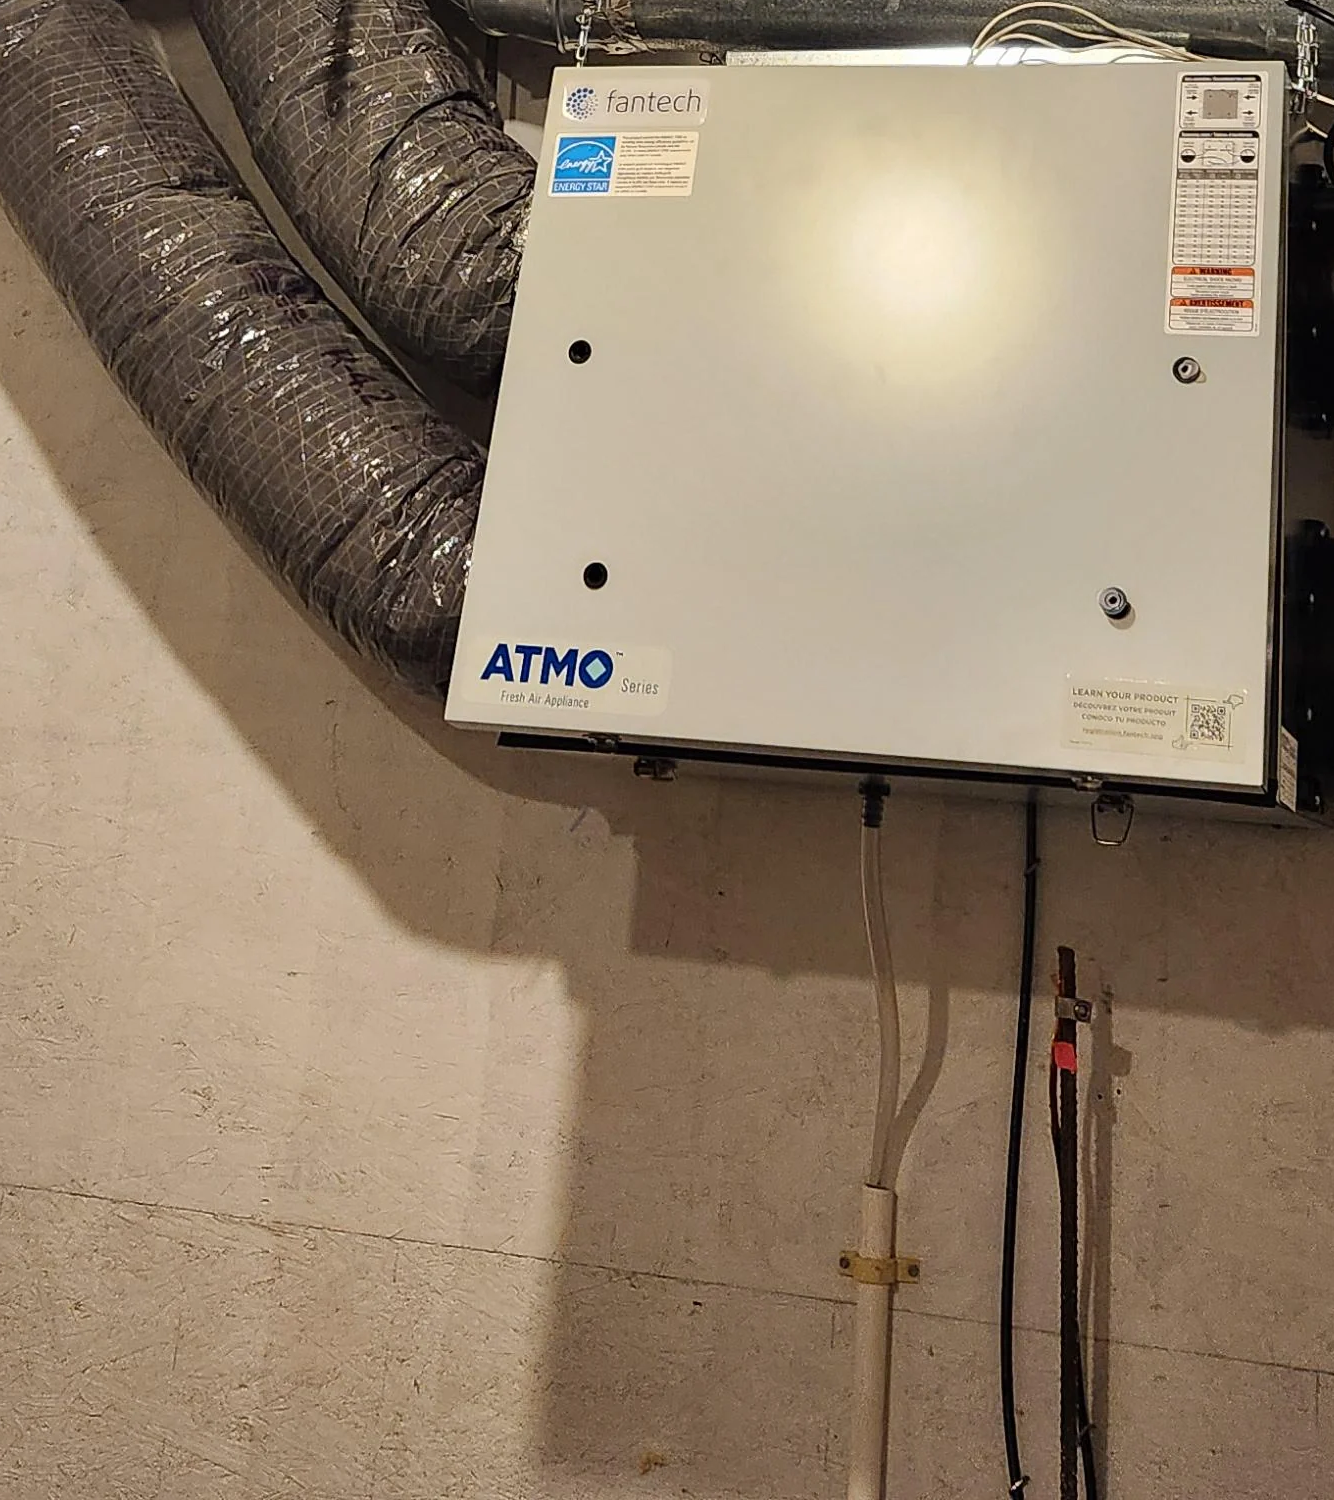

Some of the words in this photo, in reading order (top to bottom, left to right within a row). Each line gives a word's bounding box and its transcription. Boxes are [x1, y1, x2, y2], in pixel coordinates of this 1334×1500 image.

[606, 88, 701, 113] fantech
[554, 181, 585, 192] ENERGY
[586, 181, 609, 192] STAR
[480, 643, 614, 689] ATMO
[621, 678, 659, 695] Series
[501, 691, 525, 703] Fresh
[528, 693, 542, 705] Air
[544, 694, 589, 709] Appliance
[1072, 688, 1103, 697] LEARN
[1105, 691, 1131, 700] YOUR
[1134, 694, 1179, 704] PRODUCT
